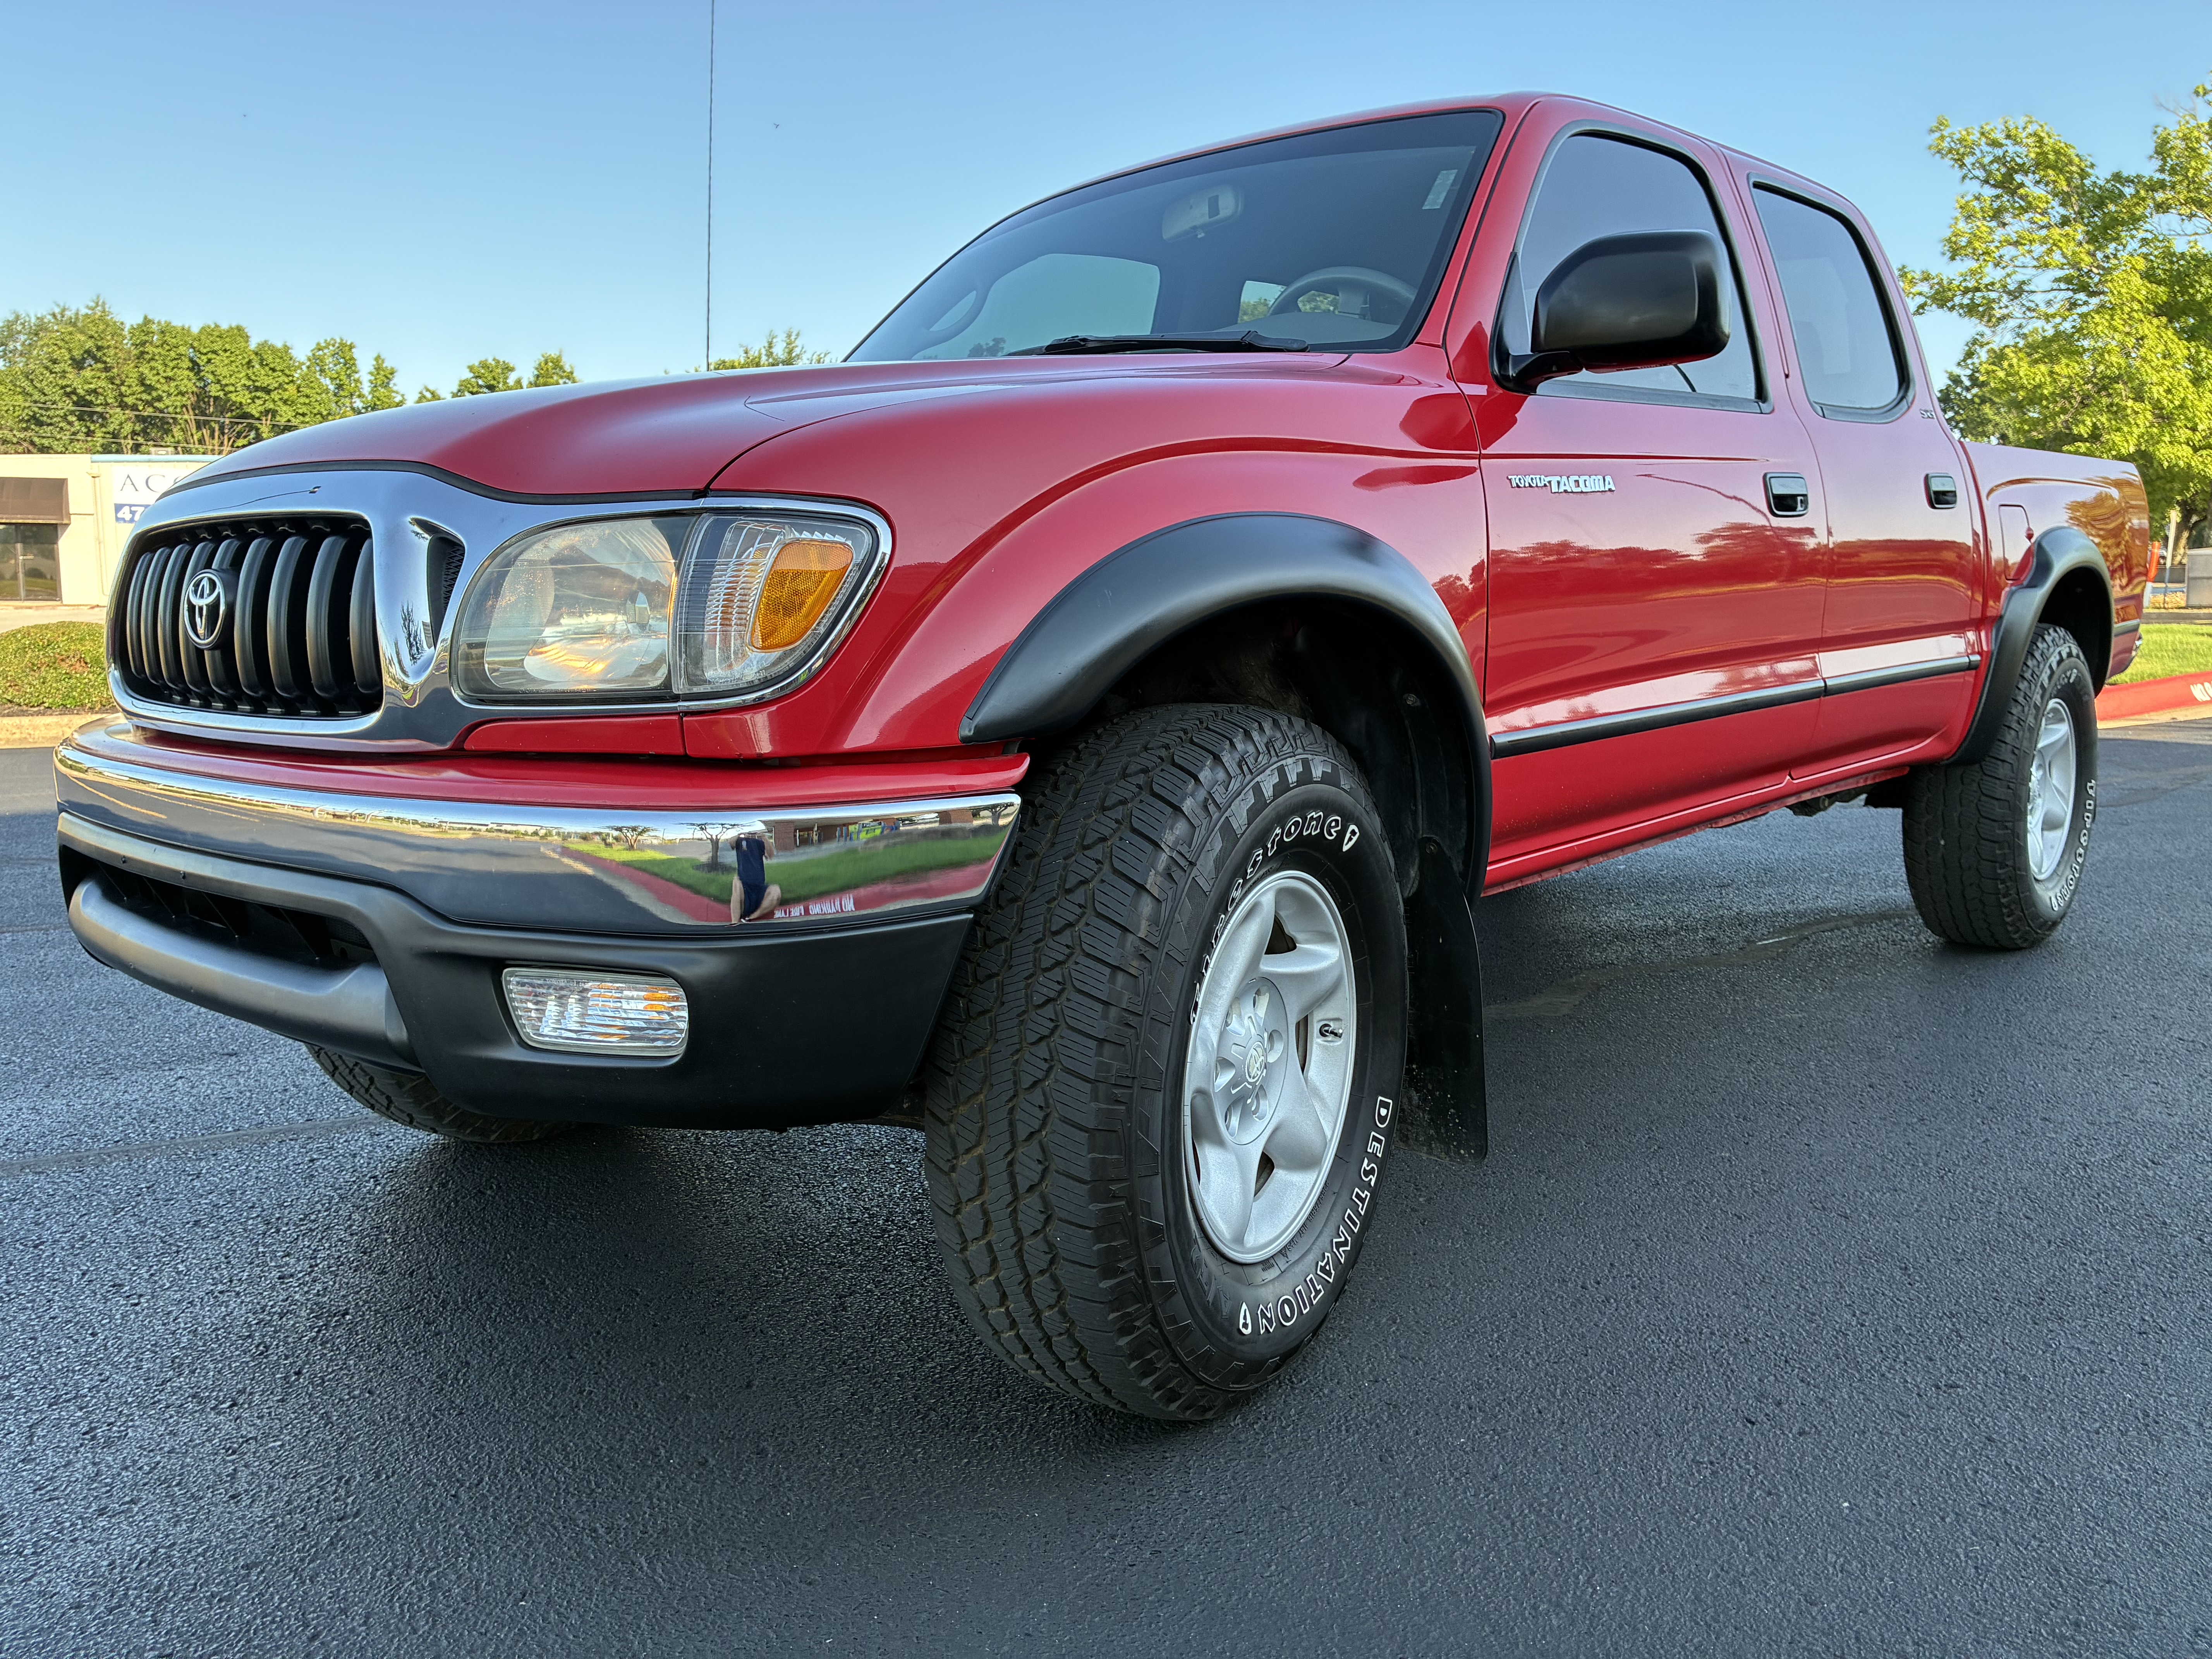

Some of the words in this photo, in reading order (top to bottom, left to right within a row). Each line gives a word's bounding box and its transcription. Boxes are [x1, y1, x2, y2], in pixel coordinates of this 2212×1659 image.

[1507, 475, 1549, 488] TOYOTA
[1546, 475, 1616, 493] TACOMA
[1259, 1096, 1393, 1335] DESTINATION
